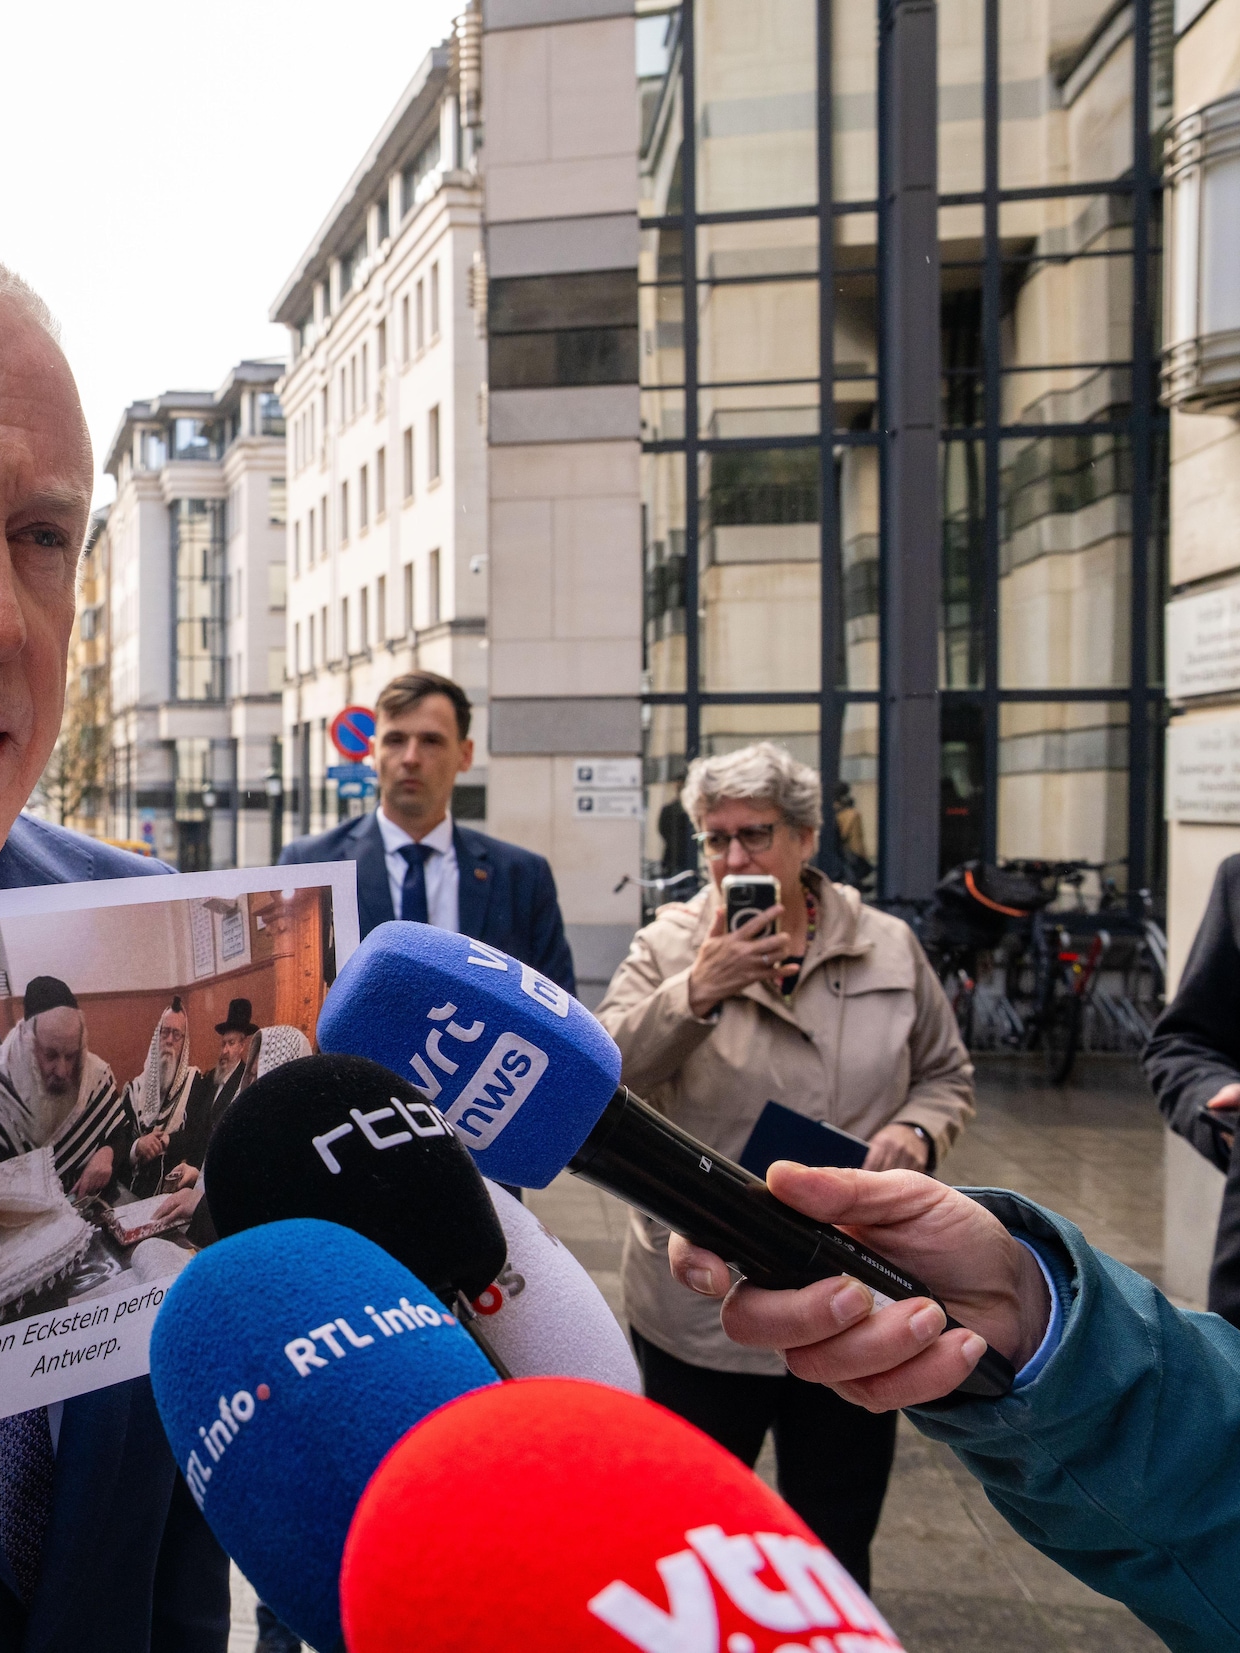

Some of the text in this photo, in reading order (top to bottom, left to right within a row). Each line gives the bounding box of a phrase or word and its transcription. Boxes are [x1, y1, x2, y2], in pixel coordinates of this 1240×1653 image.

[409, 1001, 486, 1101] vrt
[456, 1049, 532, 1138] nws
[860, 1252, 913, 1291] SENNHEISER
[21, 1305, 109, 1346] Eckstein
[284, 1317, 375, 1378] RTL
[30, 1337, 122, 1378] Antwerp.
